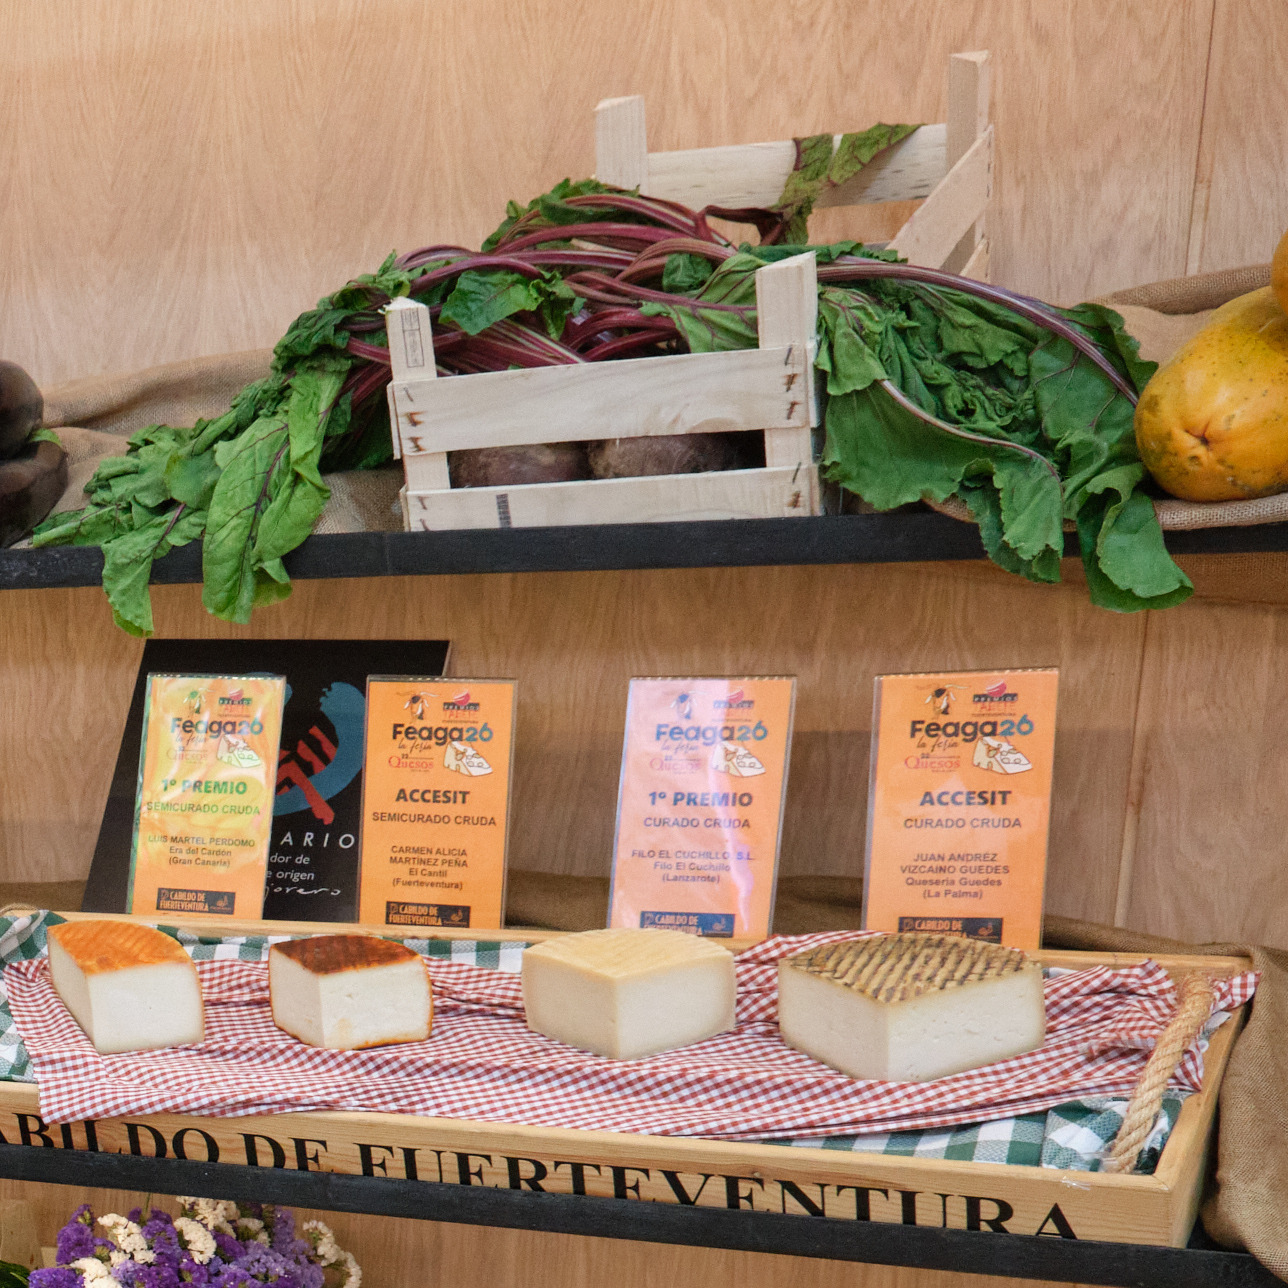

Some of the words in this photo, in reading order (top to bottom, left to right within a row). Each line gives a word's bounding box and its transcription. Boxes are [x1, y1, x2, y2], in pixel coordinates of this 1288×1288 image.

[171, 717, 263, 739] Feaga26
[656, 720, 768, 746] Feaga26
[910, 715, 1034, 743] Feaga26
[392, 723, 493, 746] Feaga26
[388, 755, 434, 770] Quesos
[904, 755, 960, 770] Quesos
[182, 779, 247, 795] PREMIO
[396, 789, 470, 804] ACCESIT
[673, 792, 753, 806] PREMIO
[920, 791, 1011, 806] ACCESIT
[146, 801, 219, 814] SEMICURADO
[222, 805, 260, 815] CRUDA
[373, 812, 450, 825] SEMICURADO
[455, 815, 496, 826] CRUDA
[644, 817, 699, 828] CURADO
[704, 818, 750, 829] CRUDA
[904, 818, 965, 829] CURADO
[970, 817, 1021, 828] CRUDA
[148, 835, 167, 843] LUIS
[170, 837, 206, 845] MARTEL
[210, 838, 254, 847] PERDOMO
[280, 831, 355, 848] ARIO
[170, 846, 183, 854] Era
[185, 846, 199, 855] del
[391, 846, 433, 855] CARMEN
[435, 847, 467, 857] ALICIA
[632, 850, 655, 858] FILO
[658, 850, 670, 859] EL
[169, 857, 192, 866] (Gran
[195, 858, 230, 868] Canaria)
[295, 855, 310, 864] de
[441, 857, 468, 868] PEÑA
[914, 853, 945, 862] JUAN
[409, 868, 418, 876] El
[421, 869, 447, 877] Cantil
[654, 862, 671, 871] Filo
[676, 862, 685, 871] El
[689, 862, 730, 872] Cuchillo
[959, 865, 1010, 874] GUEDES
[276, 870, 314, 882] origen
[662, 873, 720, 883] (Lanzarote)
[959, 877, 1002, 886] Guedes
[392, 878, 463, 890] (Fuerteventura)
[170, 891, 195, 901] CABILDO
[197, 893, 205, 902] DE
[923, 889, 940, 899] (La
[945, 889, 983, 900] Palma)
[399, 904, 428, 915] CABILDO
[429, 906, 438, 916] DE
[389, 913, 441, 926] FUERTEVENTURA
[237, 1131, 329, 1173] DE
[352, 1141, 1080, 1241] FUERTEVENTURA
